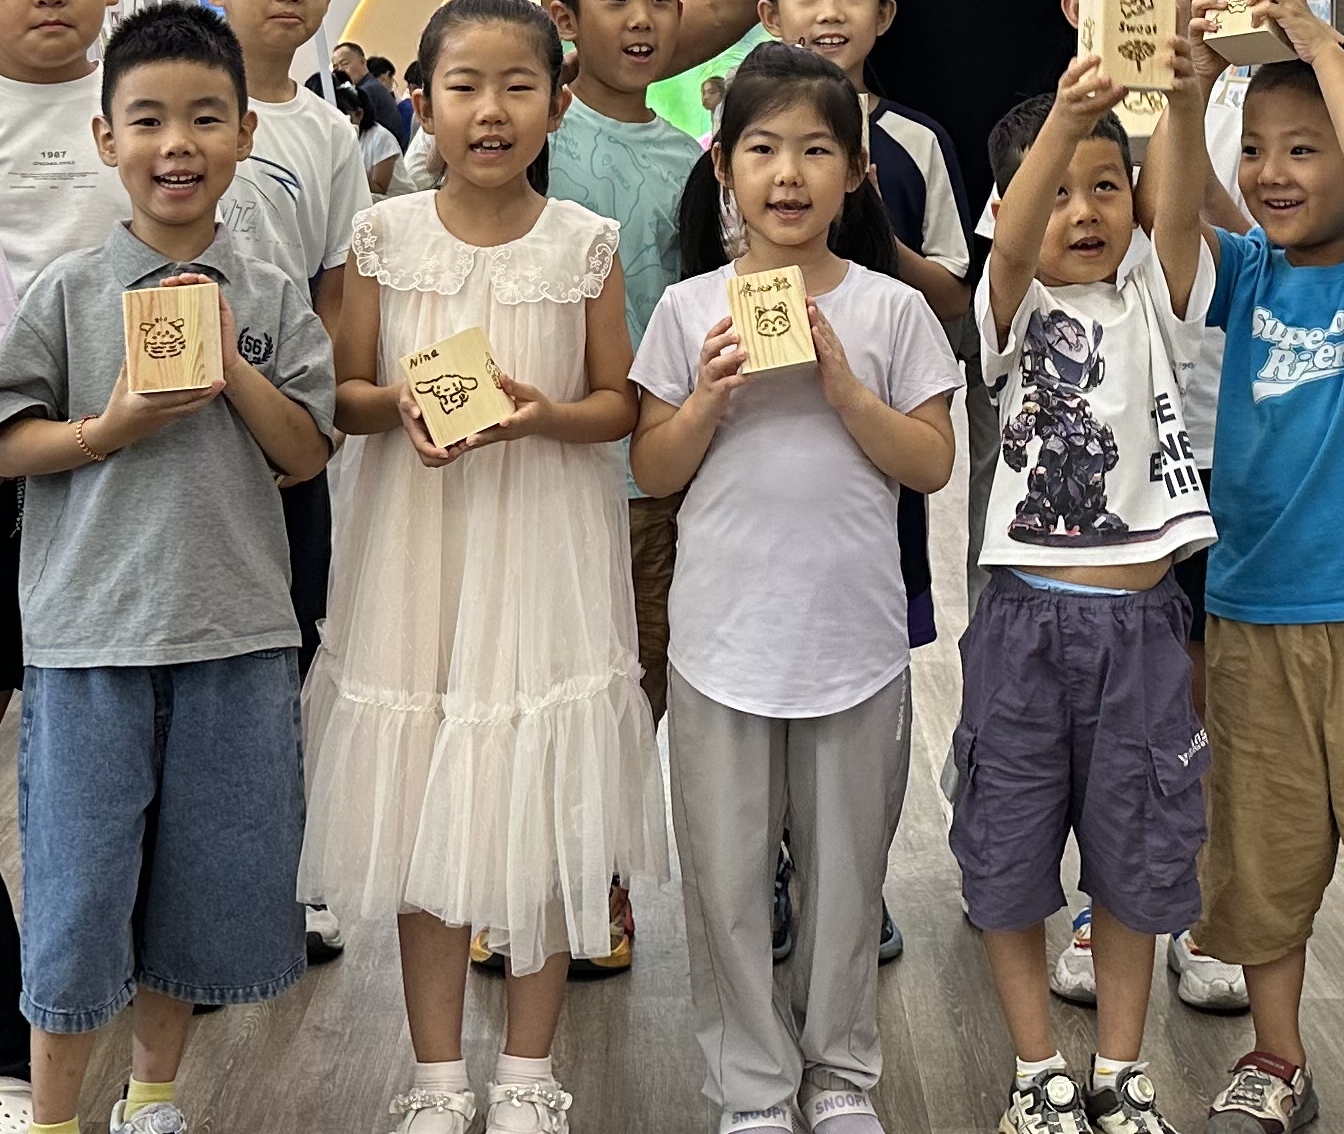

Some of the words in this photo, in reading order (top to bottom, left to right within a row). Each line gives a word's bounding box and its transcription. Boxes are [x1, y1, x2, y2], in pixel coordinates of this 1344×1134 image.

[40, 151, 67, 159] 1987
[244, 335, 263, 355] 56
[815, 1093, 869, 1115] SNOOPY
